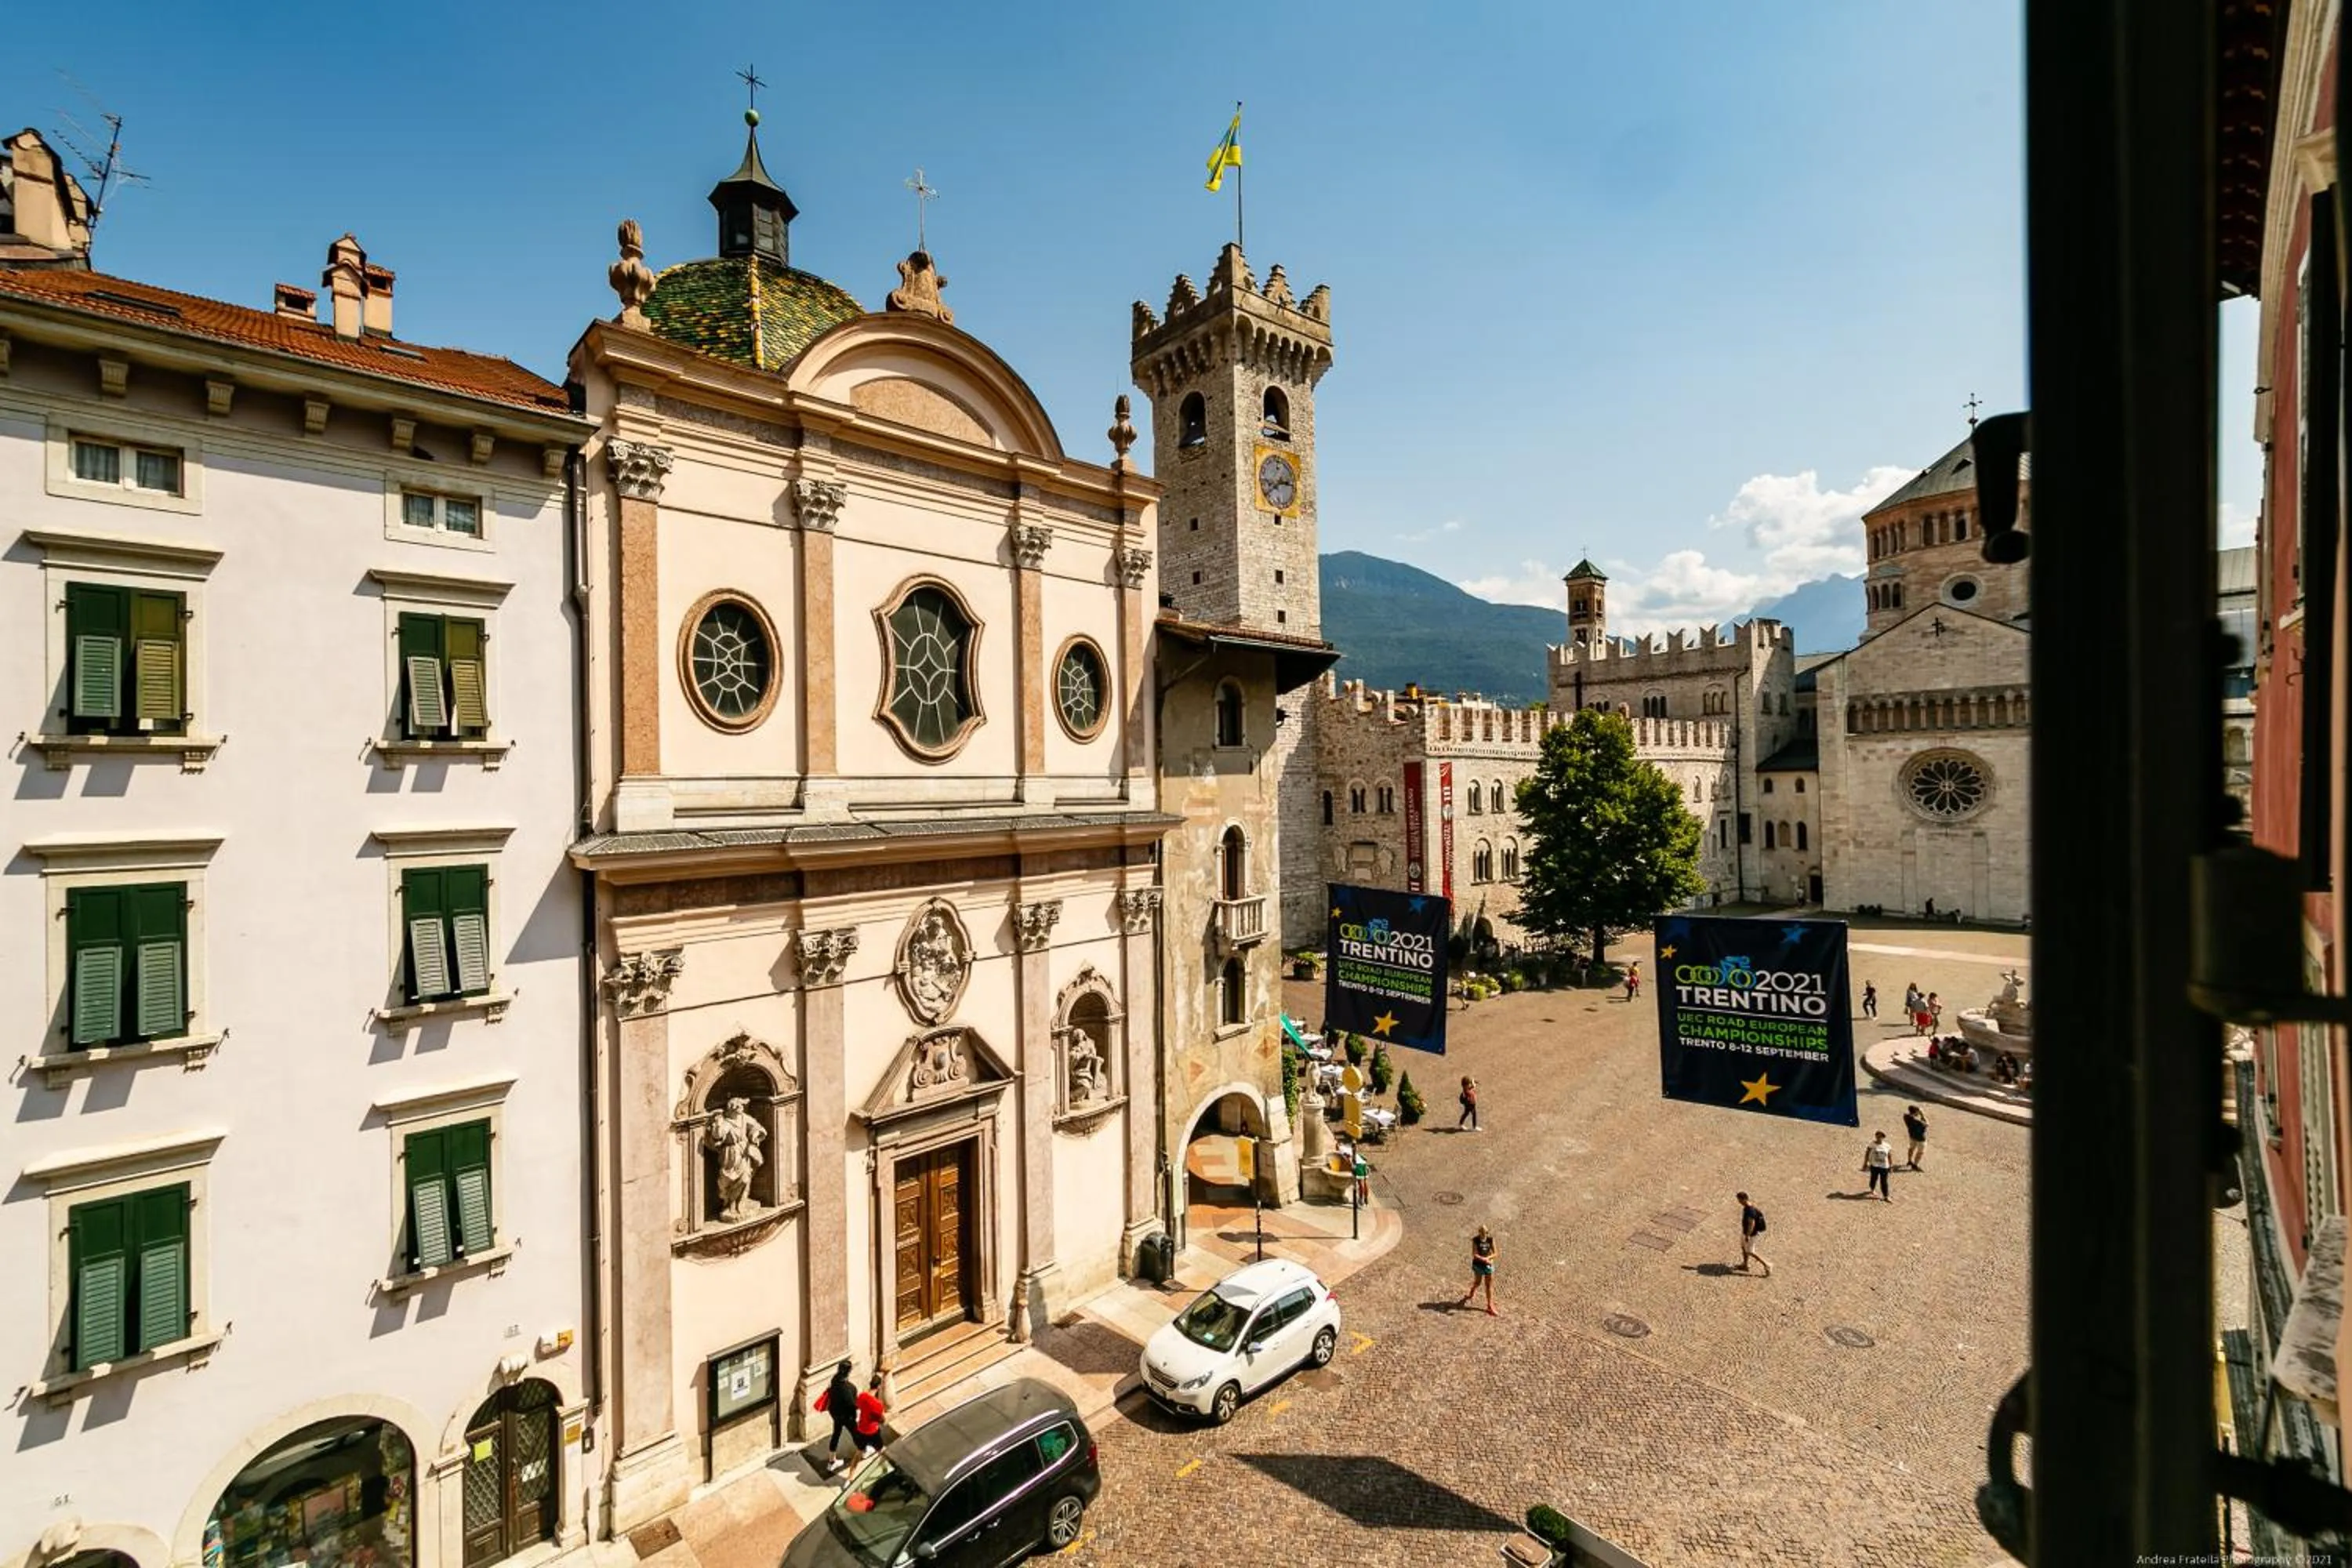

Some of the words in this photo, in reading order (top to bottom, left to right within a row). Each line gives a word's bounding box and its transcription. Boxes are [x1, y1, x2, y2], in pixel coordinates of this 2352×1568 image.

[1338, 941, 1434, 968] TRENTINO
[1390, 931, 1435, 953] 2021
[1338, 970, 1432, 996] CHAMPIONSHIPS
[1356, 964, 1382, 975] ROAD
[1384, 967, 1432, 984] EUROPEAN
[1755, 970, 1826, 995] 2021
[1338, 979, 1367, 992] TRENTO
[1385, 989, 1432, 1004] SEPTEMBER
[1675, 985, 1826, 1015] TRENTINO
[1677, 1012, 1704, 1023] UEC
[1707, 1015, 1746, 1028] ROAD
[1749, 1020, 1828, 1036] EUROPEAN
[1679, 1024, 1828, 1051] CHAMPIONSHIPS
[1679, 1036, 1726, 1050] TRENTO
[1729, 1043, 1752, 1054] 8-12
[1755, 1045, 1829, 1062] SEPTEMBER
